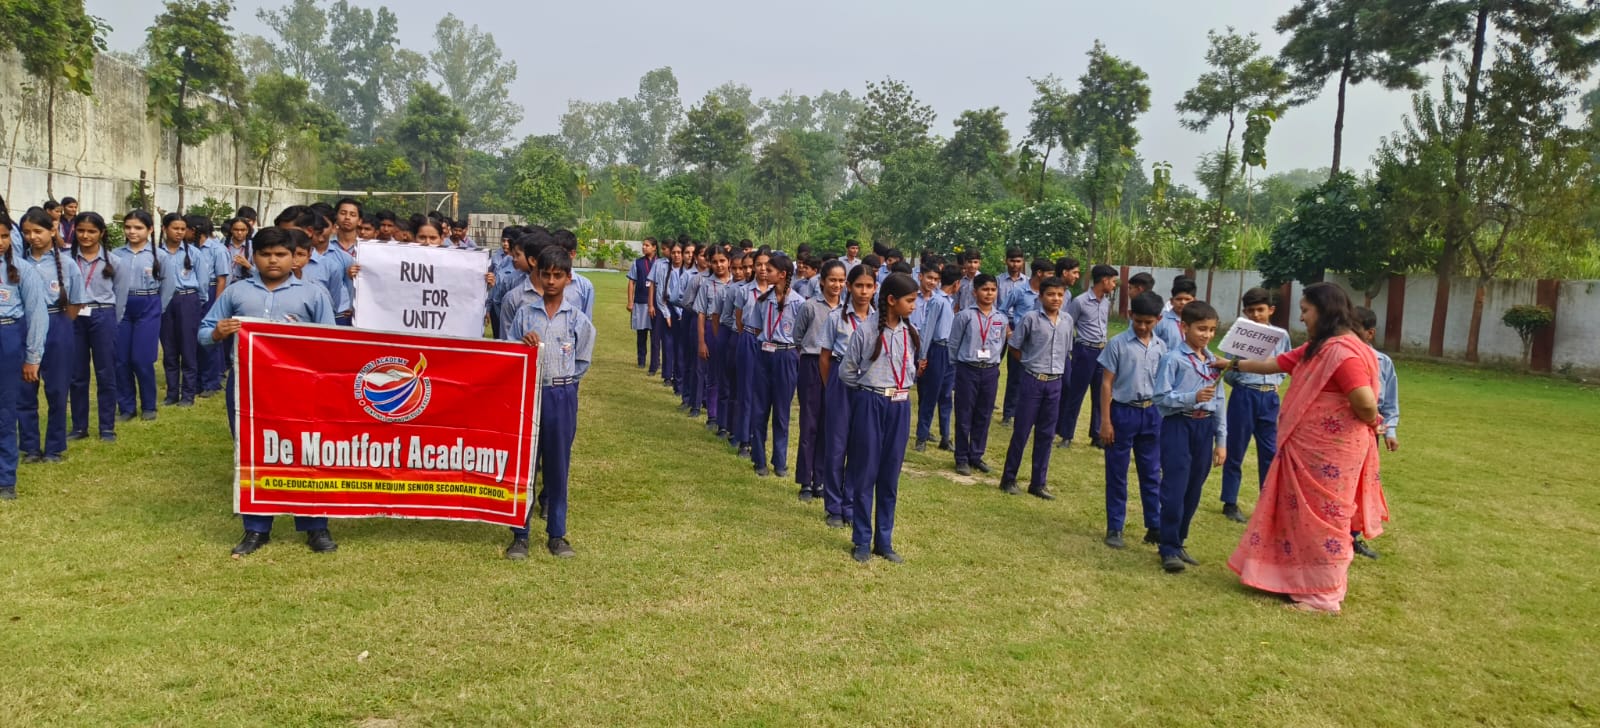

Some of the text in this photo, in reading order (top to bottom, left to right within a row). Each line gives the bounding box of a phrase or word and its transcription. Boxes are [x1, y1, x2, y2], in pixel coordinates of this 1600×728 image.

[400, 261, 434, 284] RUN
[422, 289, 449, 307] FOR
[403, 309, 446, 330] UNITY
[1235, 327, 1279, 344] TOGETHER
[1232, 340, 1267, 356] WE RISE
[376, 356, 408, 366] ACADEMY
[263, 429, 508, 482] De Montfort Academy
[265, 478, 505, 499] A CO-EDUCATIONAL ENGLISH MEDIUM SENIOR SECONDARY SCHOOL
